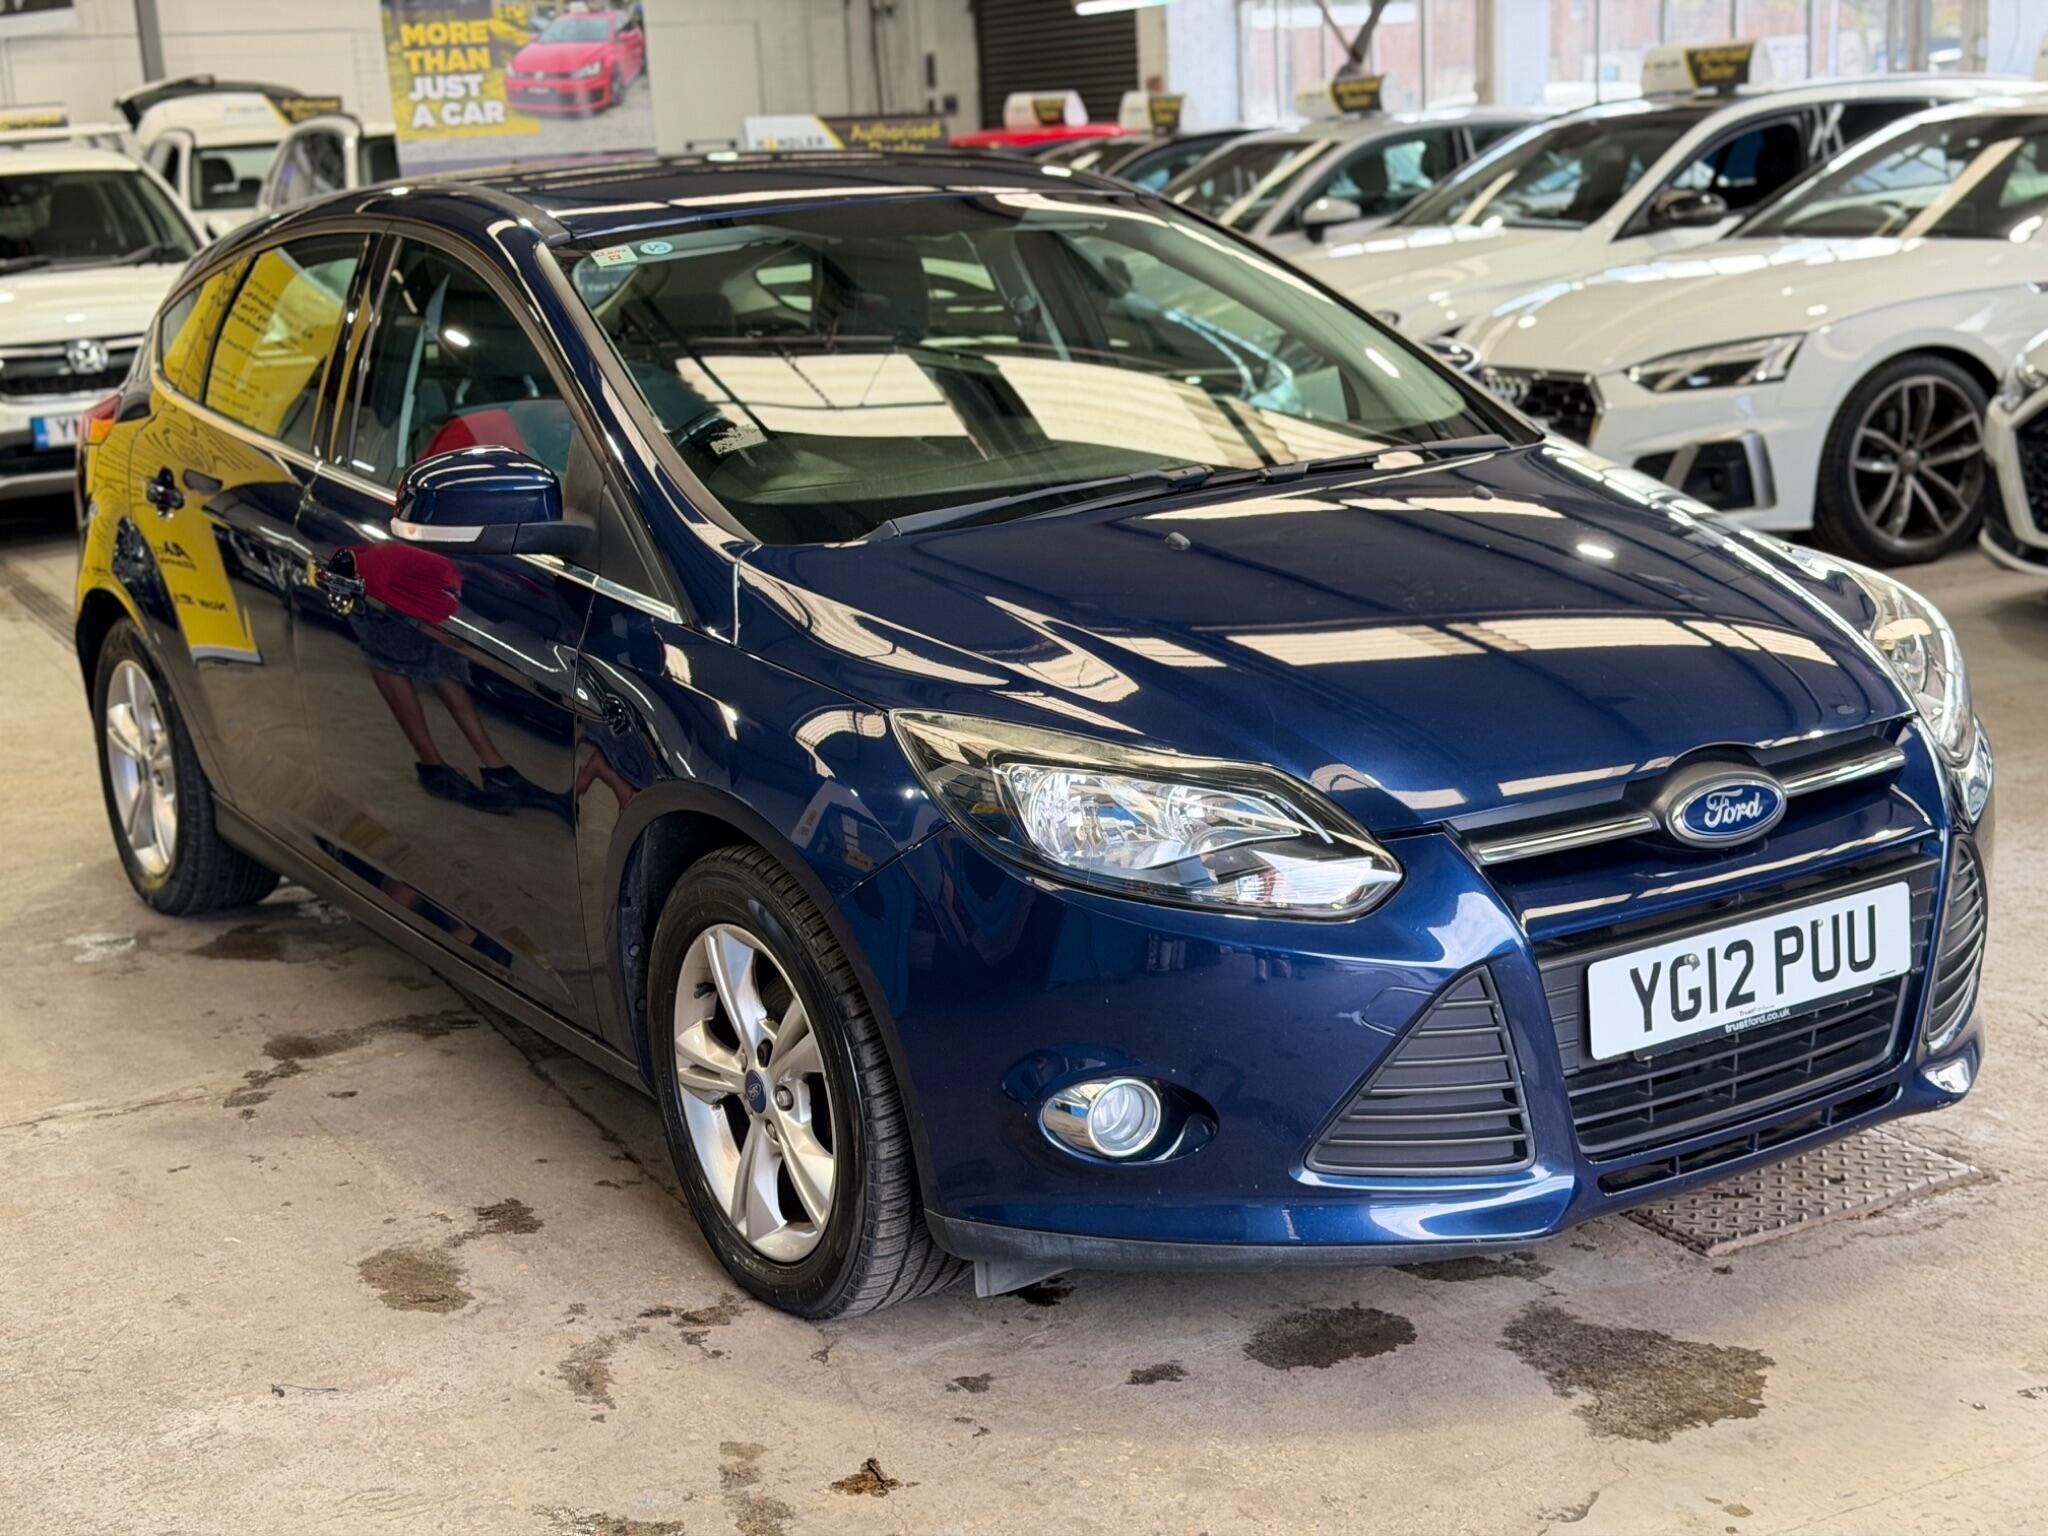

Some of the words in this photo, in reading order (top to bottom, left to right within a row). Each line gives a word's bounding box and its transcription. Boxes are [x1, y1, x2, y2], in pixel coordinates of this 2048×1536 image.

[401, 19, 490, 48] MORE
[403, 46, 491, 74] THAN
[409, 72, 483, 101] JUST
[411, 103, 436, 129] A
[440, 99, 506, 126] CAR
[1704, 788, 1763, 828] Ford
[1629, 938, 1756, 1033] YG12
[1774, 904, 1877, 996] PUU
[1724, 1008, 1791, 1034] trustford.co.uk
